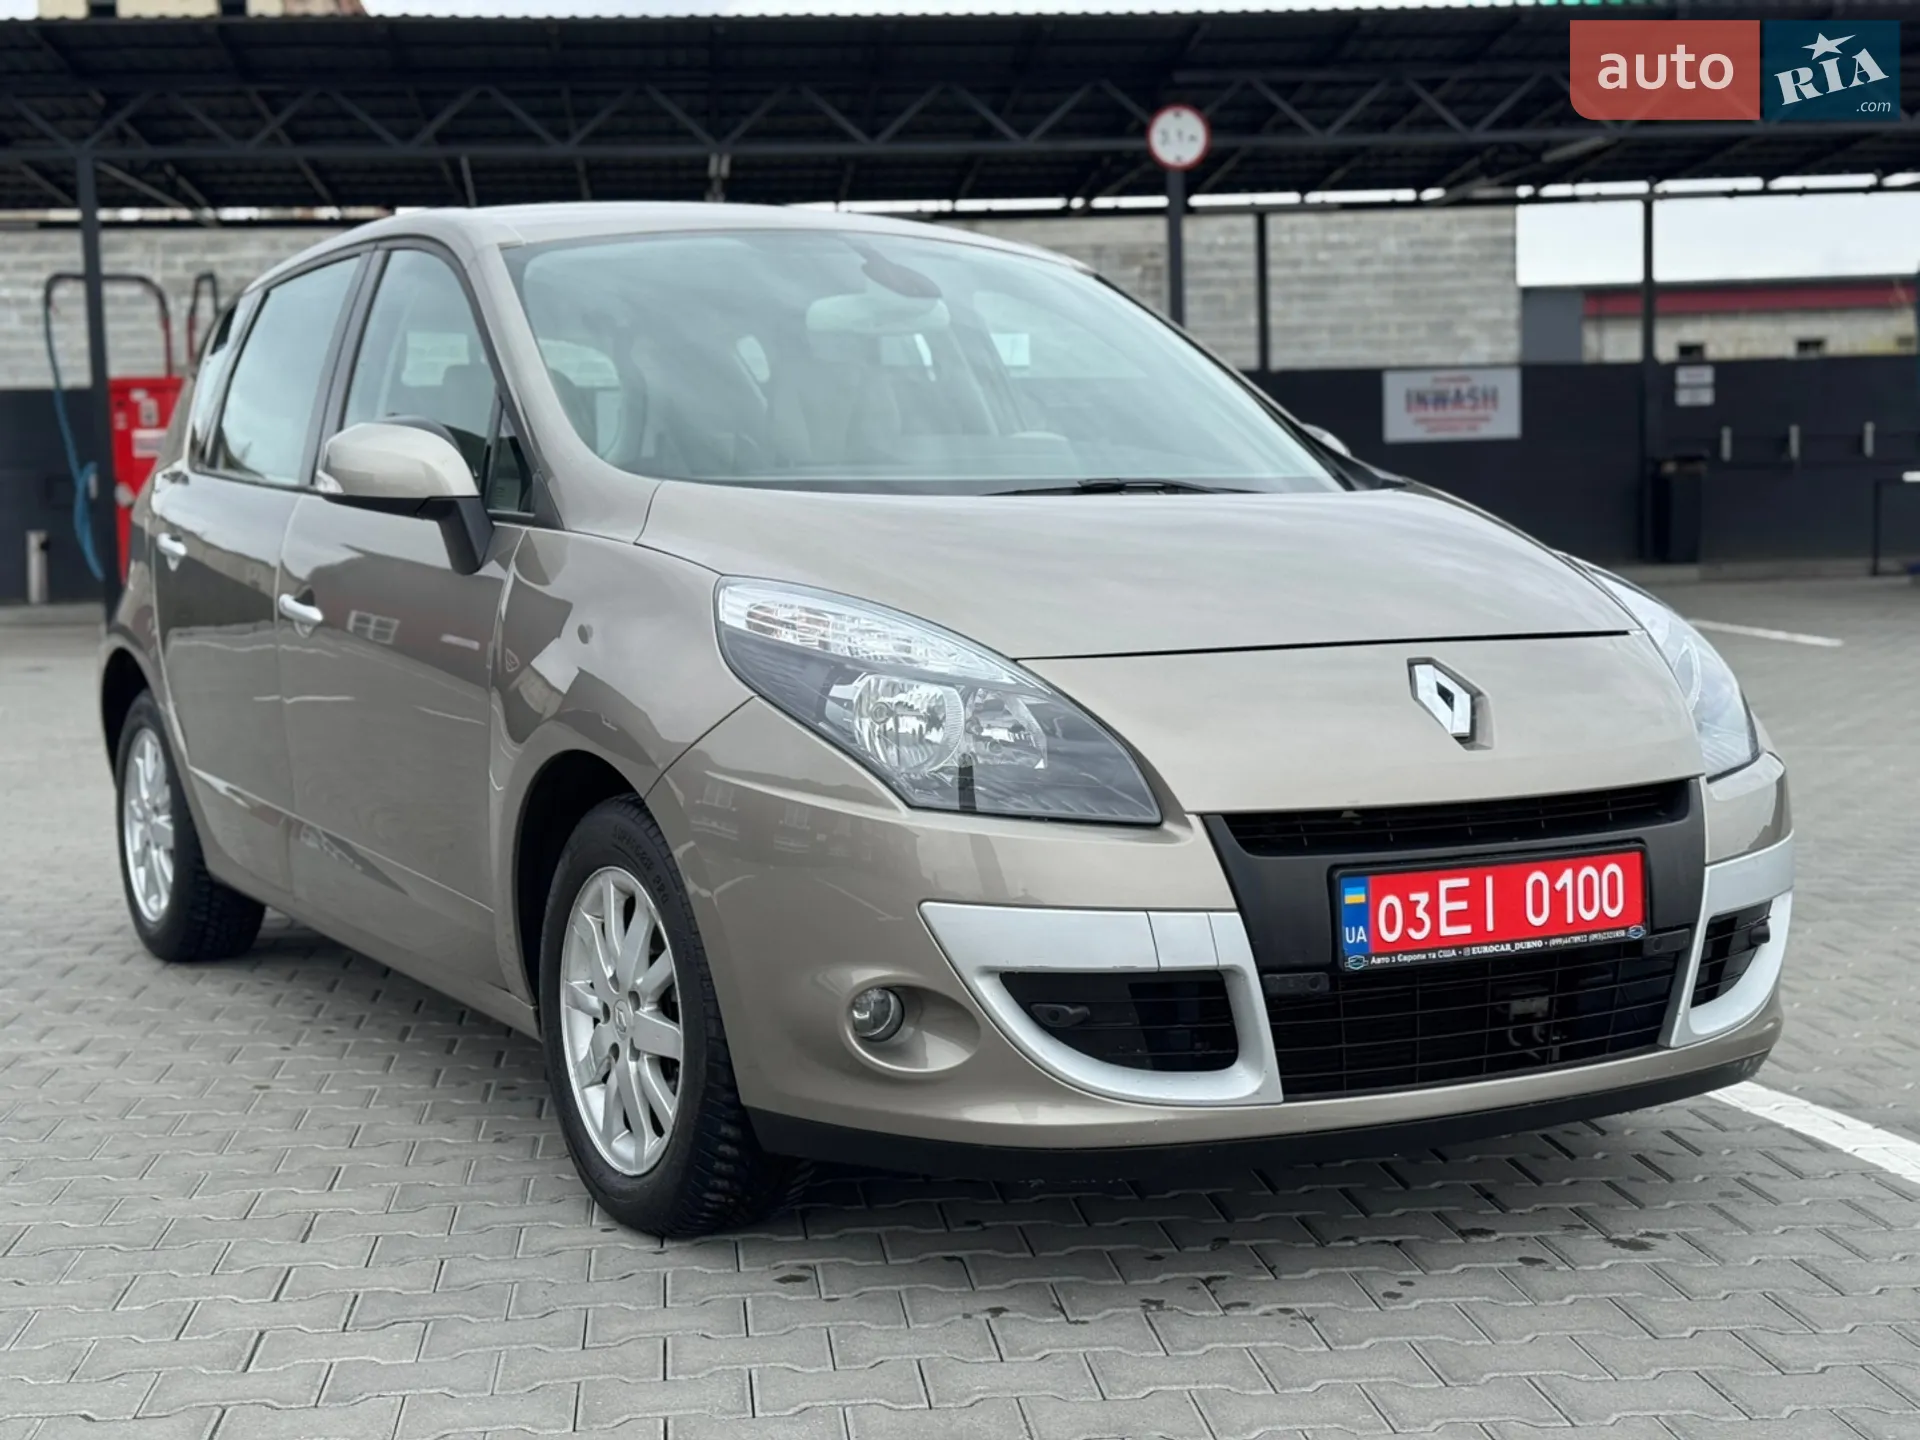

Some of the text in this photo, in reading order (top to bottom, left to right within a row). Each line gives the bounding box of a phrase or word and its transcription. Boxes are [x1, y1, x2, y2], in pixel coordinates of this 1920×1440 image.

[1525, 863, 1625, 927] 0100
[1345, 926, 1368, 945] UA
[1371, 956, 1390, 965] Авто
[1437, 949, 1457, 958] США
